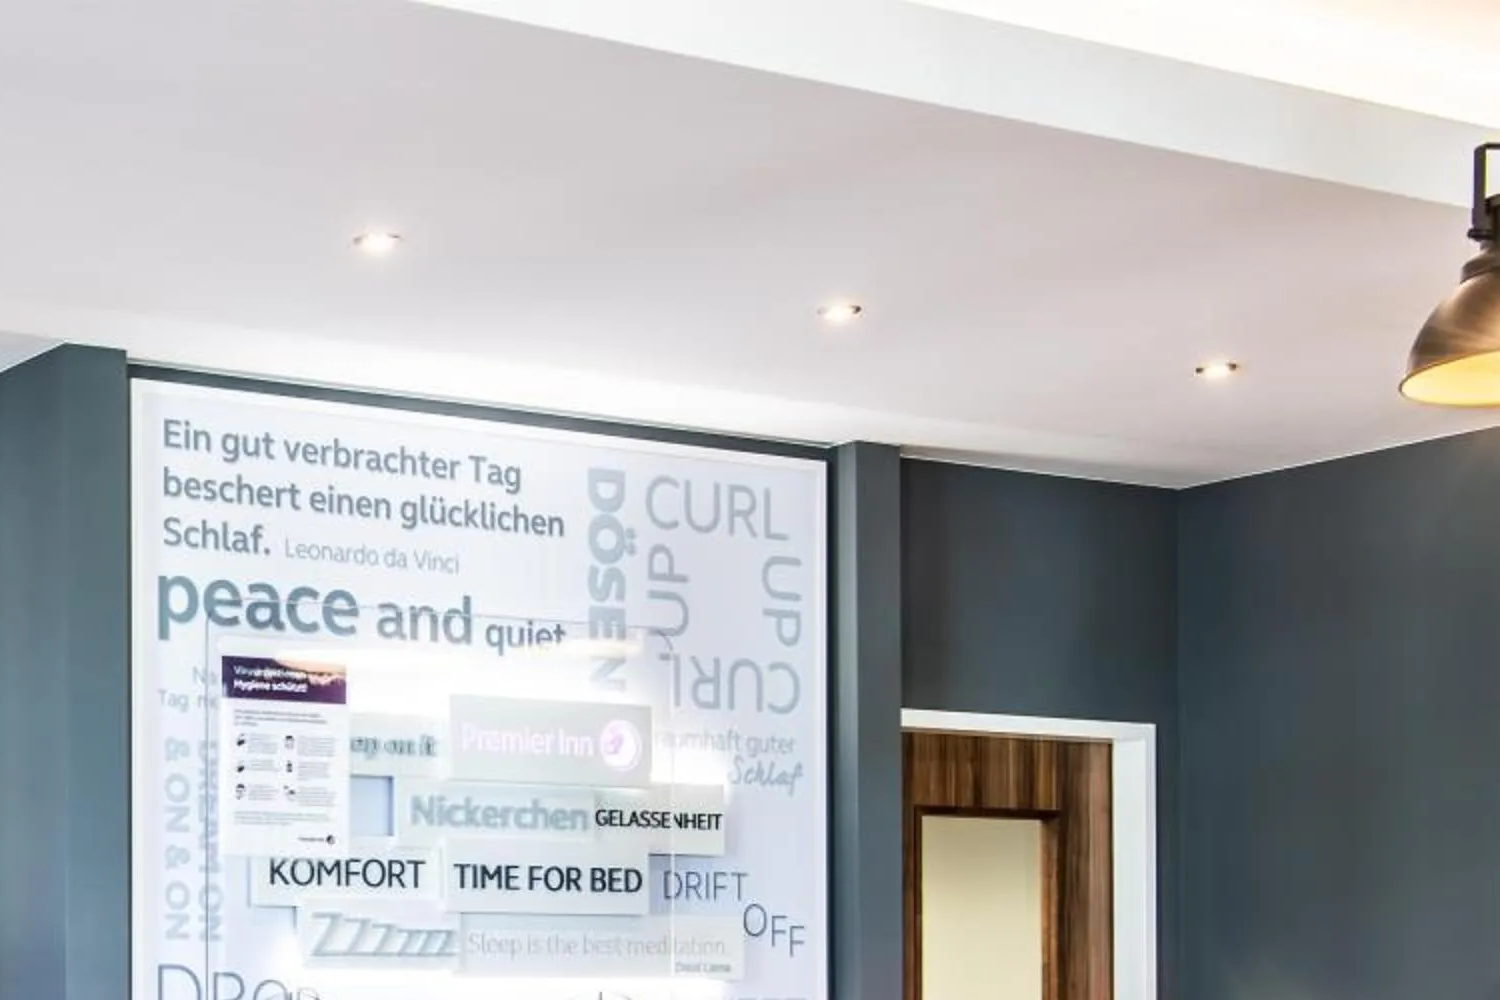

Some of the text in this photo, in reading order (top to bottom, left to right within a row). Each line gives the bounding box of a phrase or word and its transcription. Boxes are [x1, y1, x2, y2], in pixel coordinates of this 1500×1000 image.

[163, 419, 521, 494] Ein gut verbrachter Tag
[163, 467, 565, 537] beschert einen glücklichen
[645, 475, 789, 541] CURL
[163, 516, 460, 573] Schlaf. Leonardo da Vinci
[157, 574, 567, 656] peace and quiet
[646, 544, 690, 637] UP
[761, 555, 803, 647] UP
[156, 689, 190, 713] Tag
[658, 653, 800, 714] CURL
[462, 720, 595, 757] Premier Inn
[655, 728, 797, 758] raumhaft guter
[164, 772, 191, 833] ON
[730, 754, 804, 798] Schlaf
[411, 795, 589, 832] Nickerchen
[595, 809, 723, 831] GELASSENHEIT
[269, 858, 426, 889] KOMFORT
[454, 863, 643, 893] TIME FOR BED
[663, 870, 748, 901] DRIFT
[164, 880, 191, 940] ON
[743, 903, 805, 958] OFF
[468, 931, 522, 962] Sleep
[527, 932, 541, 955] is
[547, 932, 579, 955] the
[583, 932, 622, 956] best
